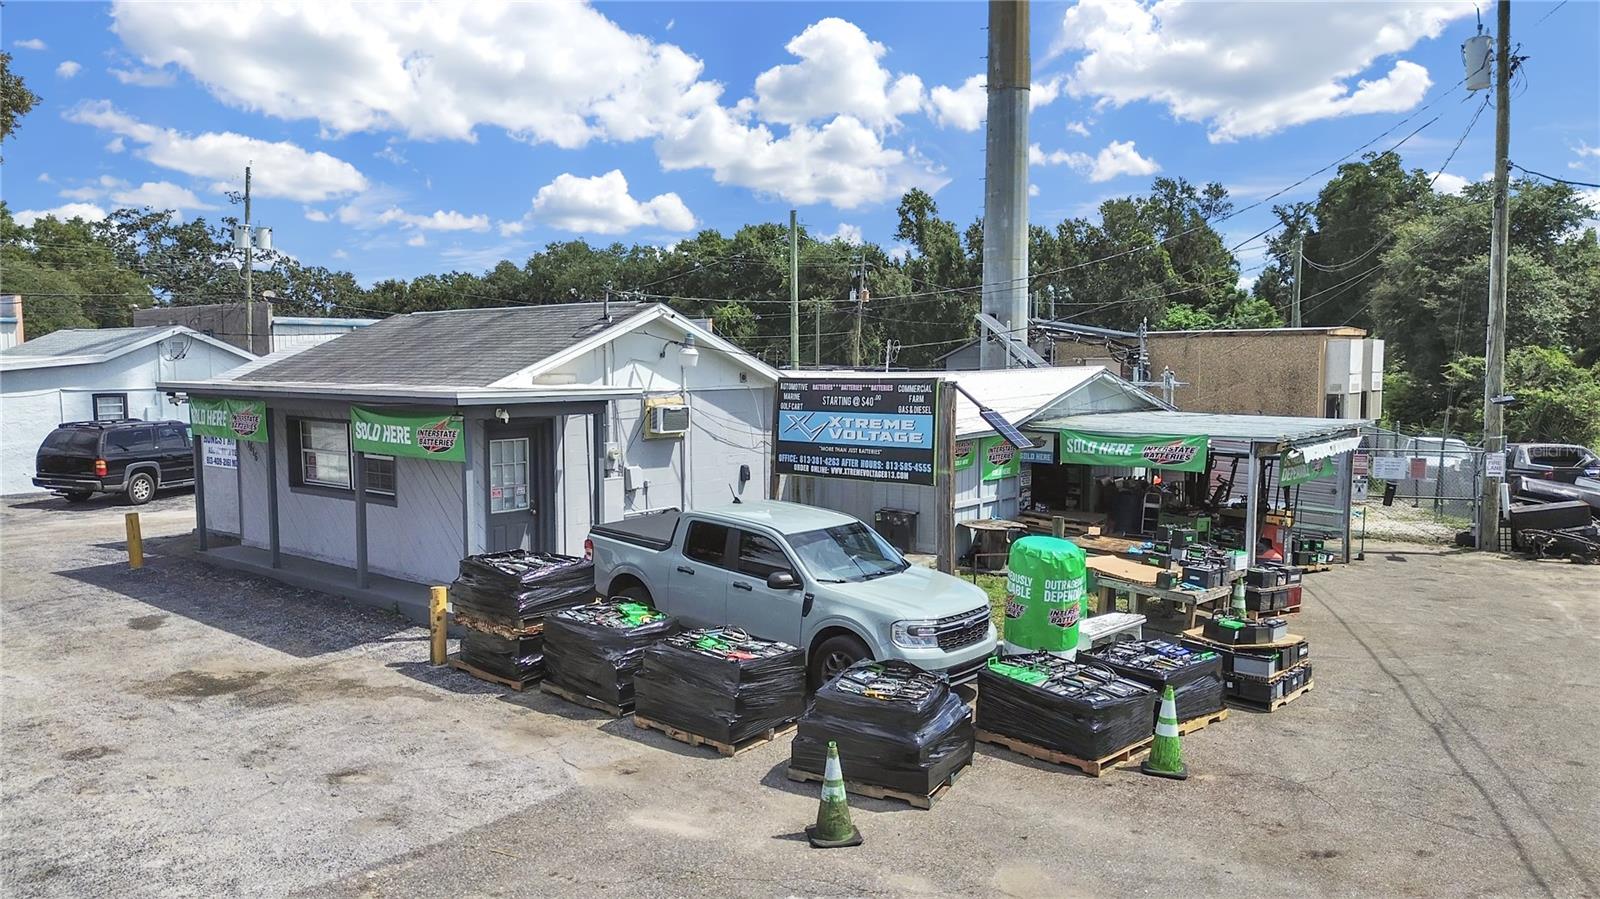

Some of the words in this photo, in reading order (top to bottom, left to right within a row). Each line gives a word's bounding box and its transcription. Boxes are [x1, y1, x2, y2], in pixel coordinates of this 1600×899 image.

[780, 383, 808, 391] AUTOMOTIVE
[897, 384, 932, 393] COMMERCIAL
[783, 393, 801, 401] MARINE
[822, 396, 852, 406] STARTING
[852, 396, 861, 407] @
[908, 395, 924, 403] FARM
[780, 402, 791, 410] GOLF
[206, 409, 227, 427] HERE
[829, 416, 915, 431] XTREME
[355, 421, 381, 442] SOLD
[382, 424, 412, 445] HERE
[417, 429, 457, 438] INTERSTATE
[829, 428, 924, 444] VOLTAGE
[418, 438, 455, 447] BATTERIES
[1066, 438, 1097, 454] SOLD
[1100, 443, 1135, 456] HERE
[1143, 445, 1196, 454] INTERSTATE
[1143, 452, 1191, 461] BATTERIES
[778, 454, 798, 463] OFFICE:
[841, 458, 859, 468] AFTER
[860, 459, 884, 470] HOURS:
[794, 464, 810, 472] ORDER
[811, 465, 829, 474] ONLINE:
